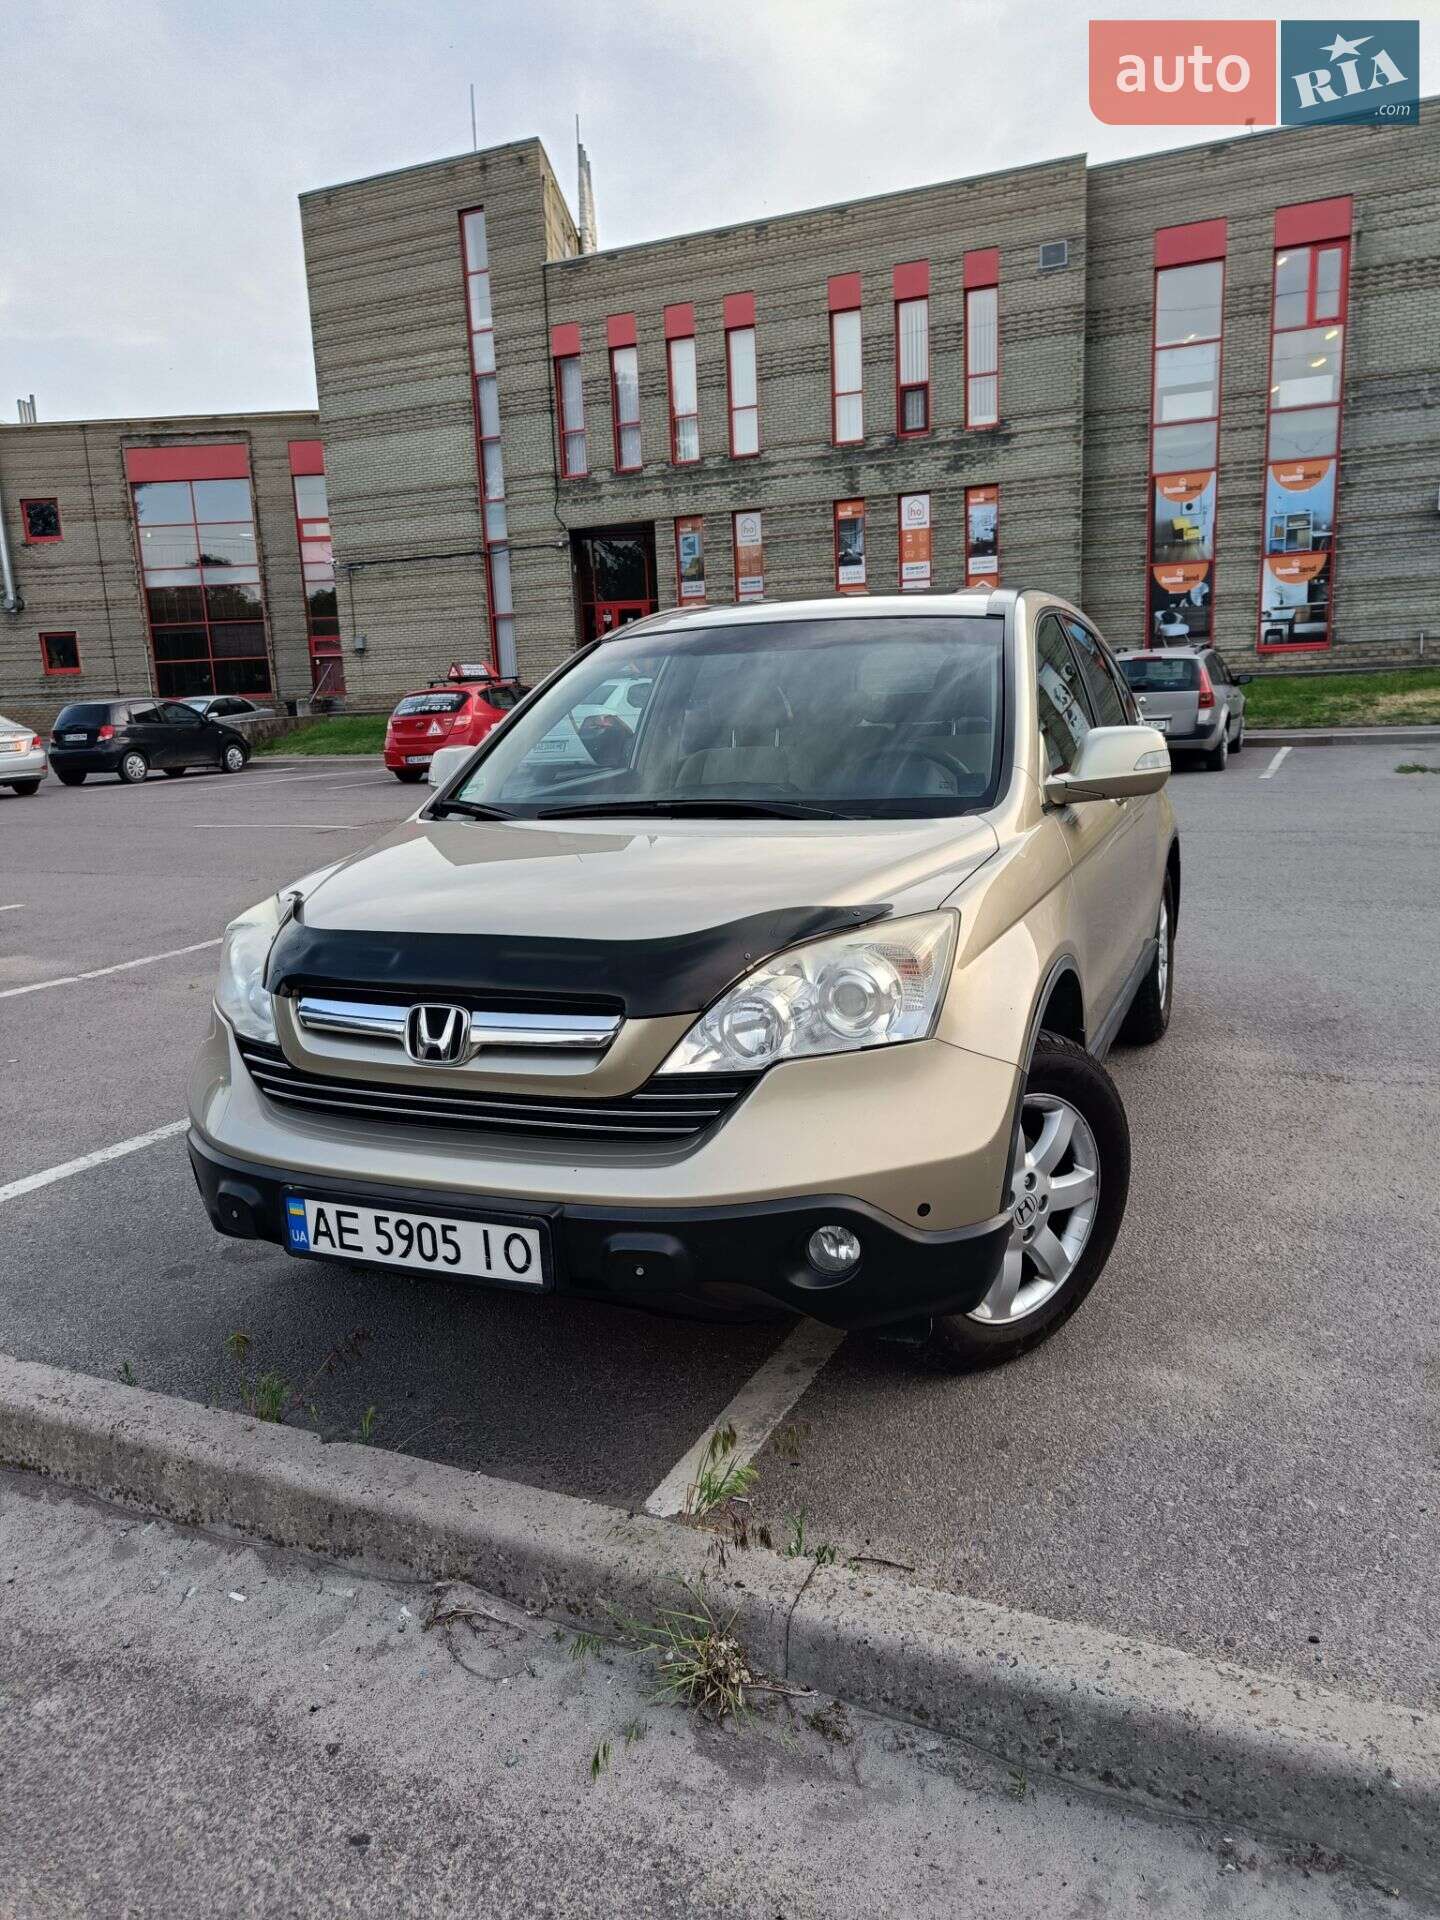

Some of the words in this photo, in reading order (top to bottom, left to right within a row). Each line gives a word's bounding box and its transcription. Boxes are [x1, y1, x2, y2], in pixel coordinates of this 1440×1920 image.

[291, 1230, 308, 1243] UA
[312, 1207, 364, 1252] AE
[373, 1215, 462, 1265] 5905
[482, 1229, 532, 1274] IO
